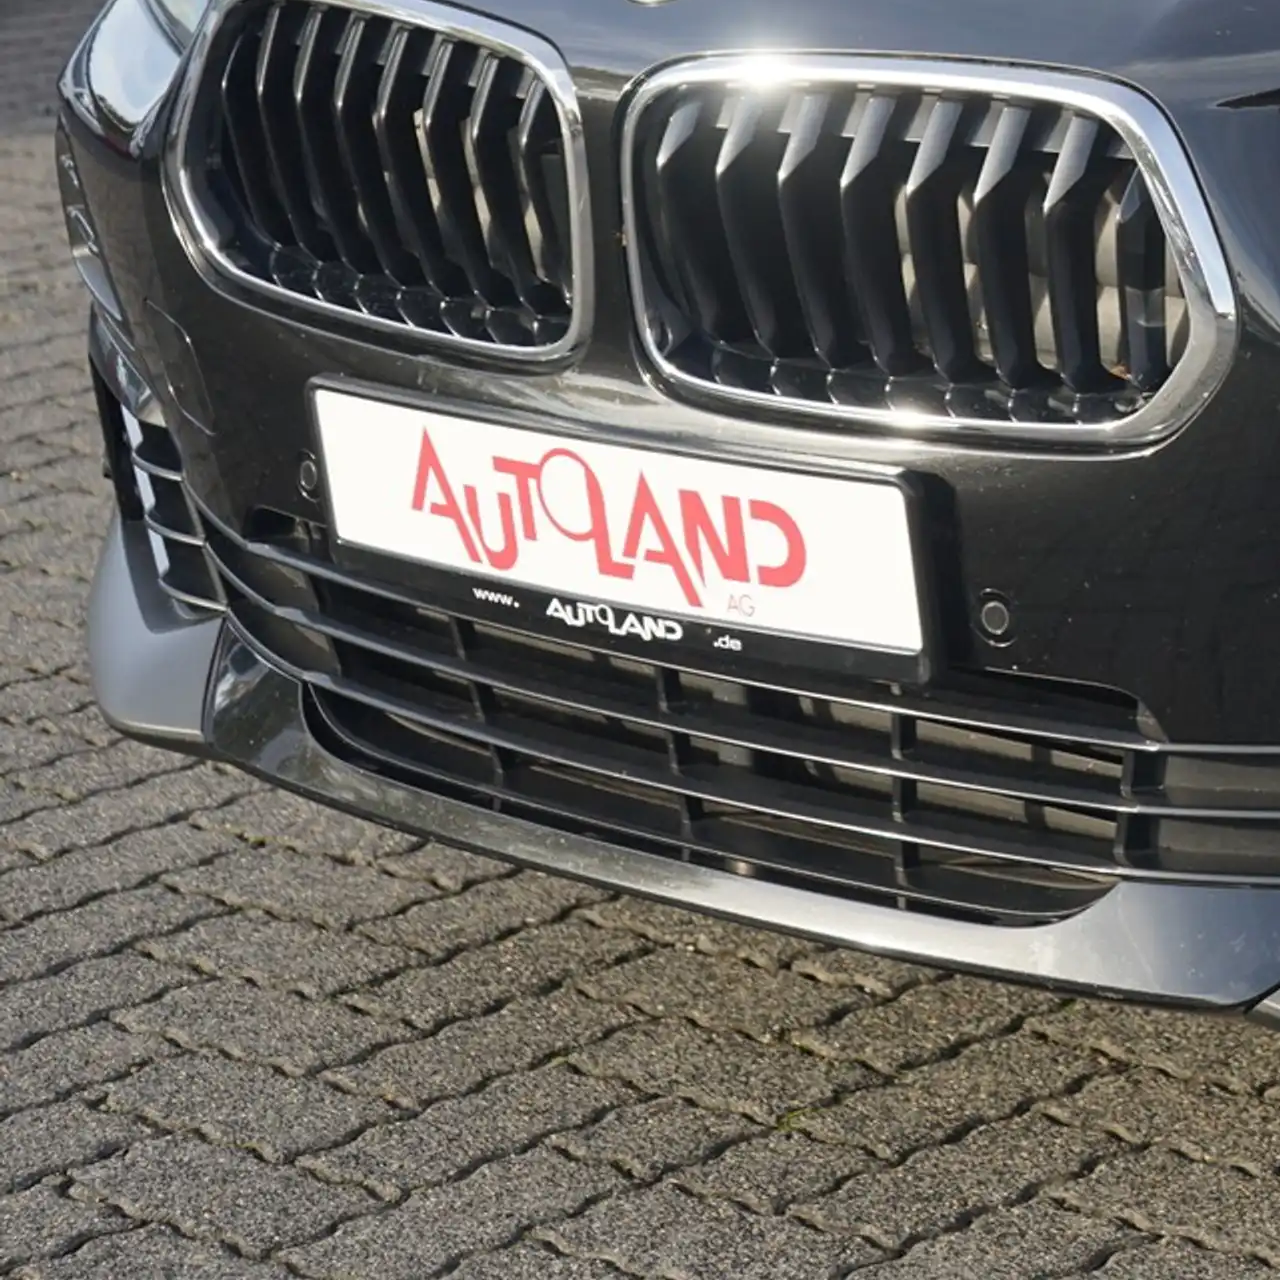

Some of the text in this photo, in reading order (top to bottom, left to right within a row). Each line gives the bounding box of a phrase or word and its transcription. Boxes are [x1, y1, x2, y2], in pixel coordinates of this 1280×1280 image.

[412, 426, 807, 608] AUTOLAND
[545, 597, 683, 641] AUTOLAND
[727, 593, 756, 618] AG
